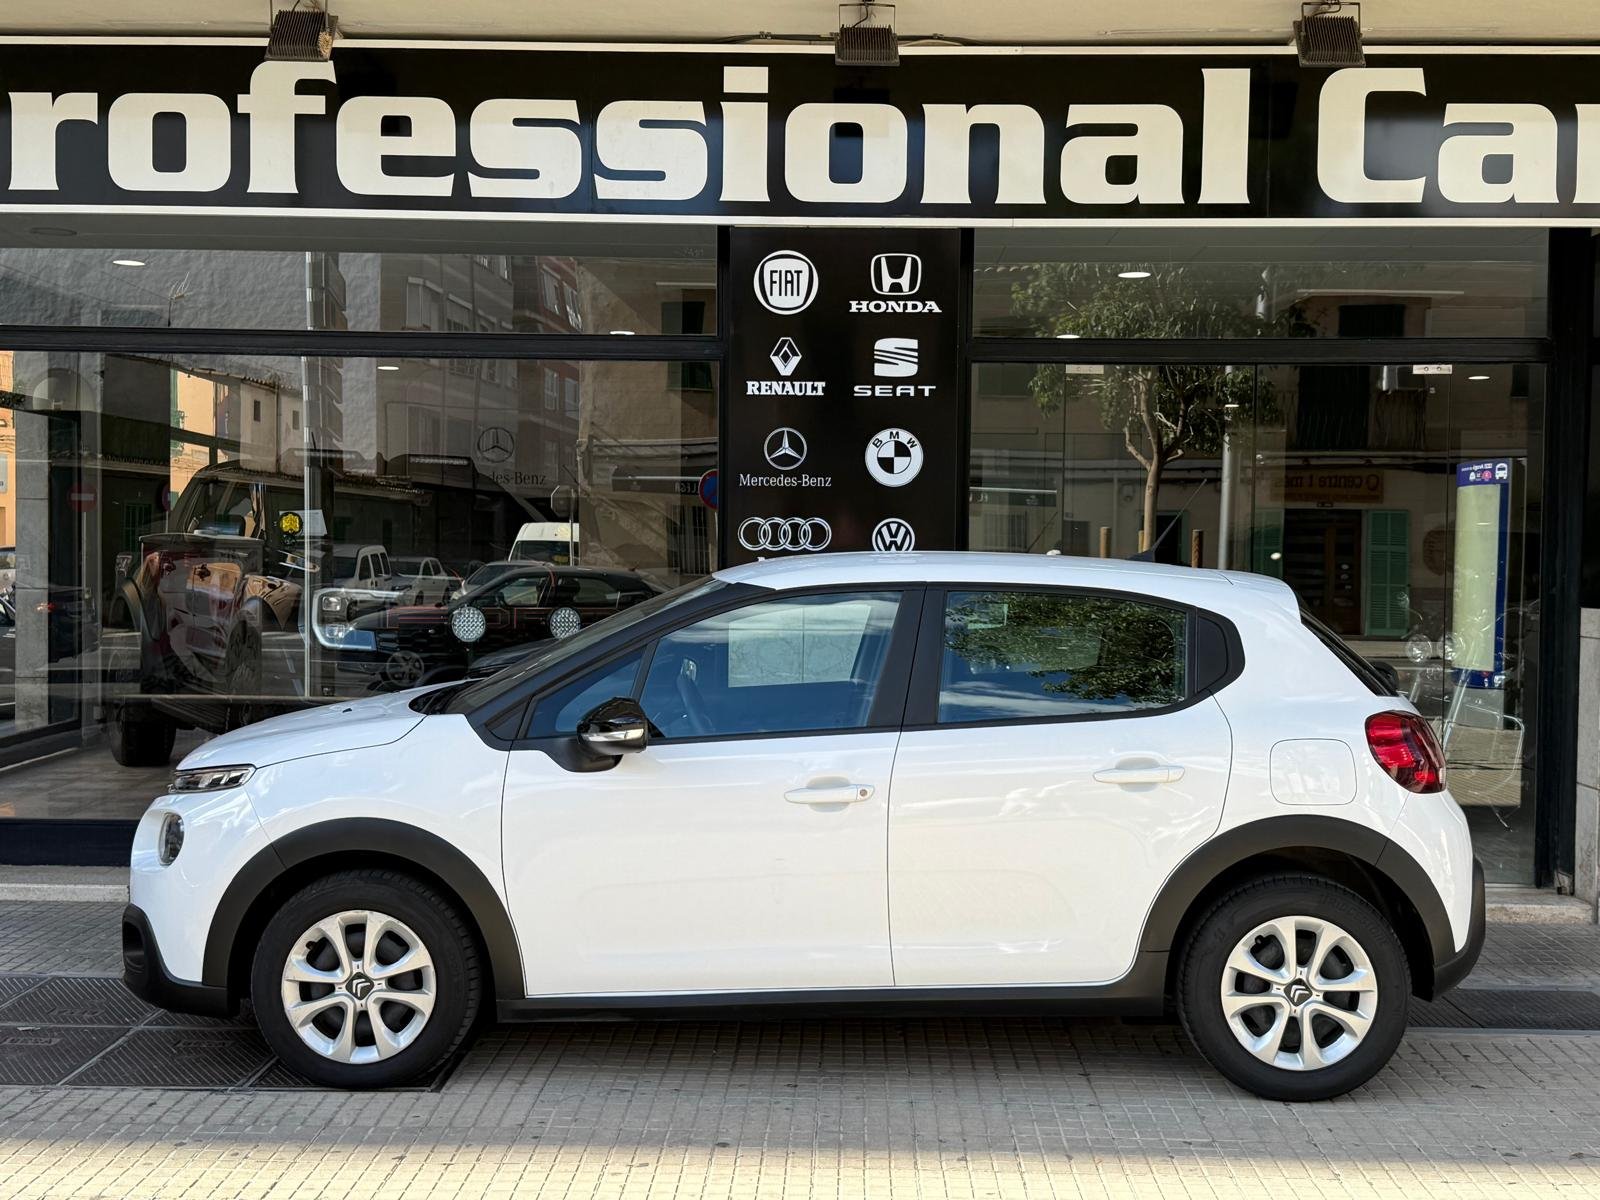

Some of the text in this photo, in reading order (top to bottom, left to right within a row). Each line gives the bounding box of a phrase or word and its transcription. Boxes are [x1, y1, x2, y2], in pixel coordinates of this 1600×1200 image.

[1317, 67, 1600, 204] Ca
[769, 269, 803, 297] FIAT
[849, 300, 942, 313] HONDA
[746, 381, 826, 396] RENAULT
[853, 385, 937, 397] SEAT
[872, 430, 917, 449] BMW
[739, 473, 832, 488] Mercedes-Benz
